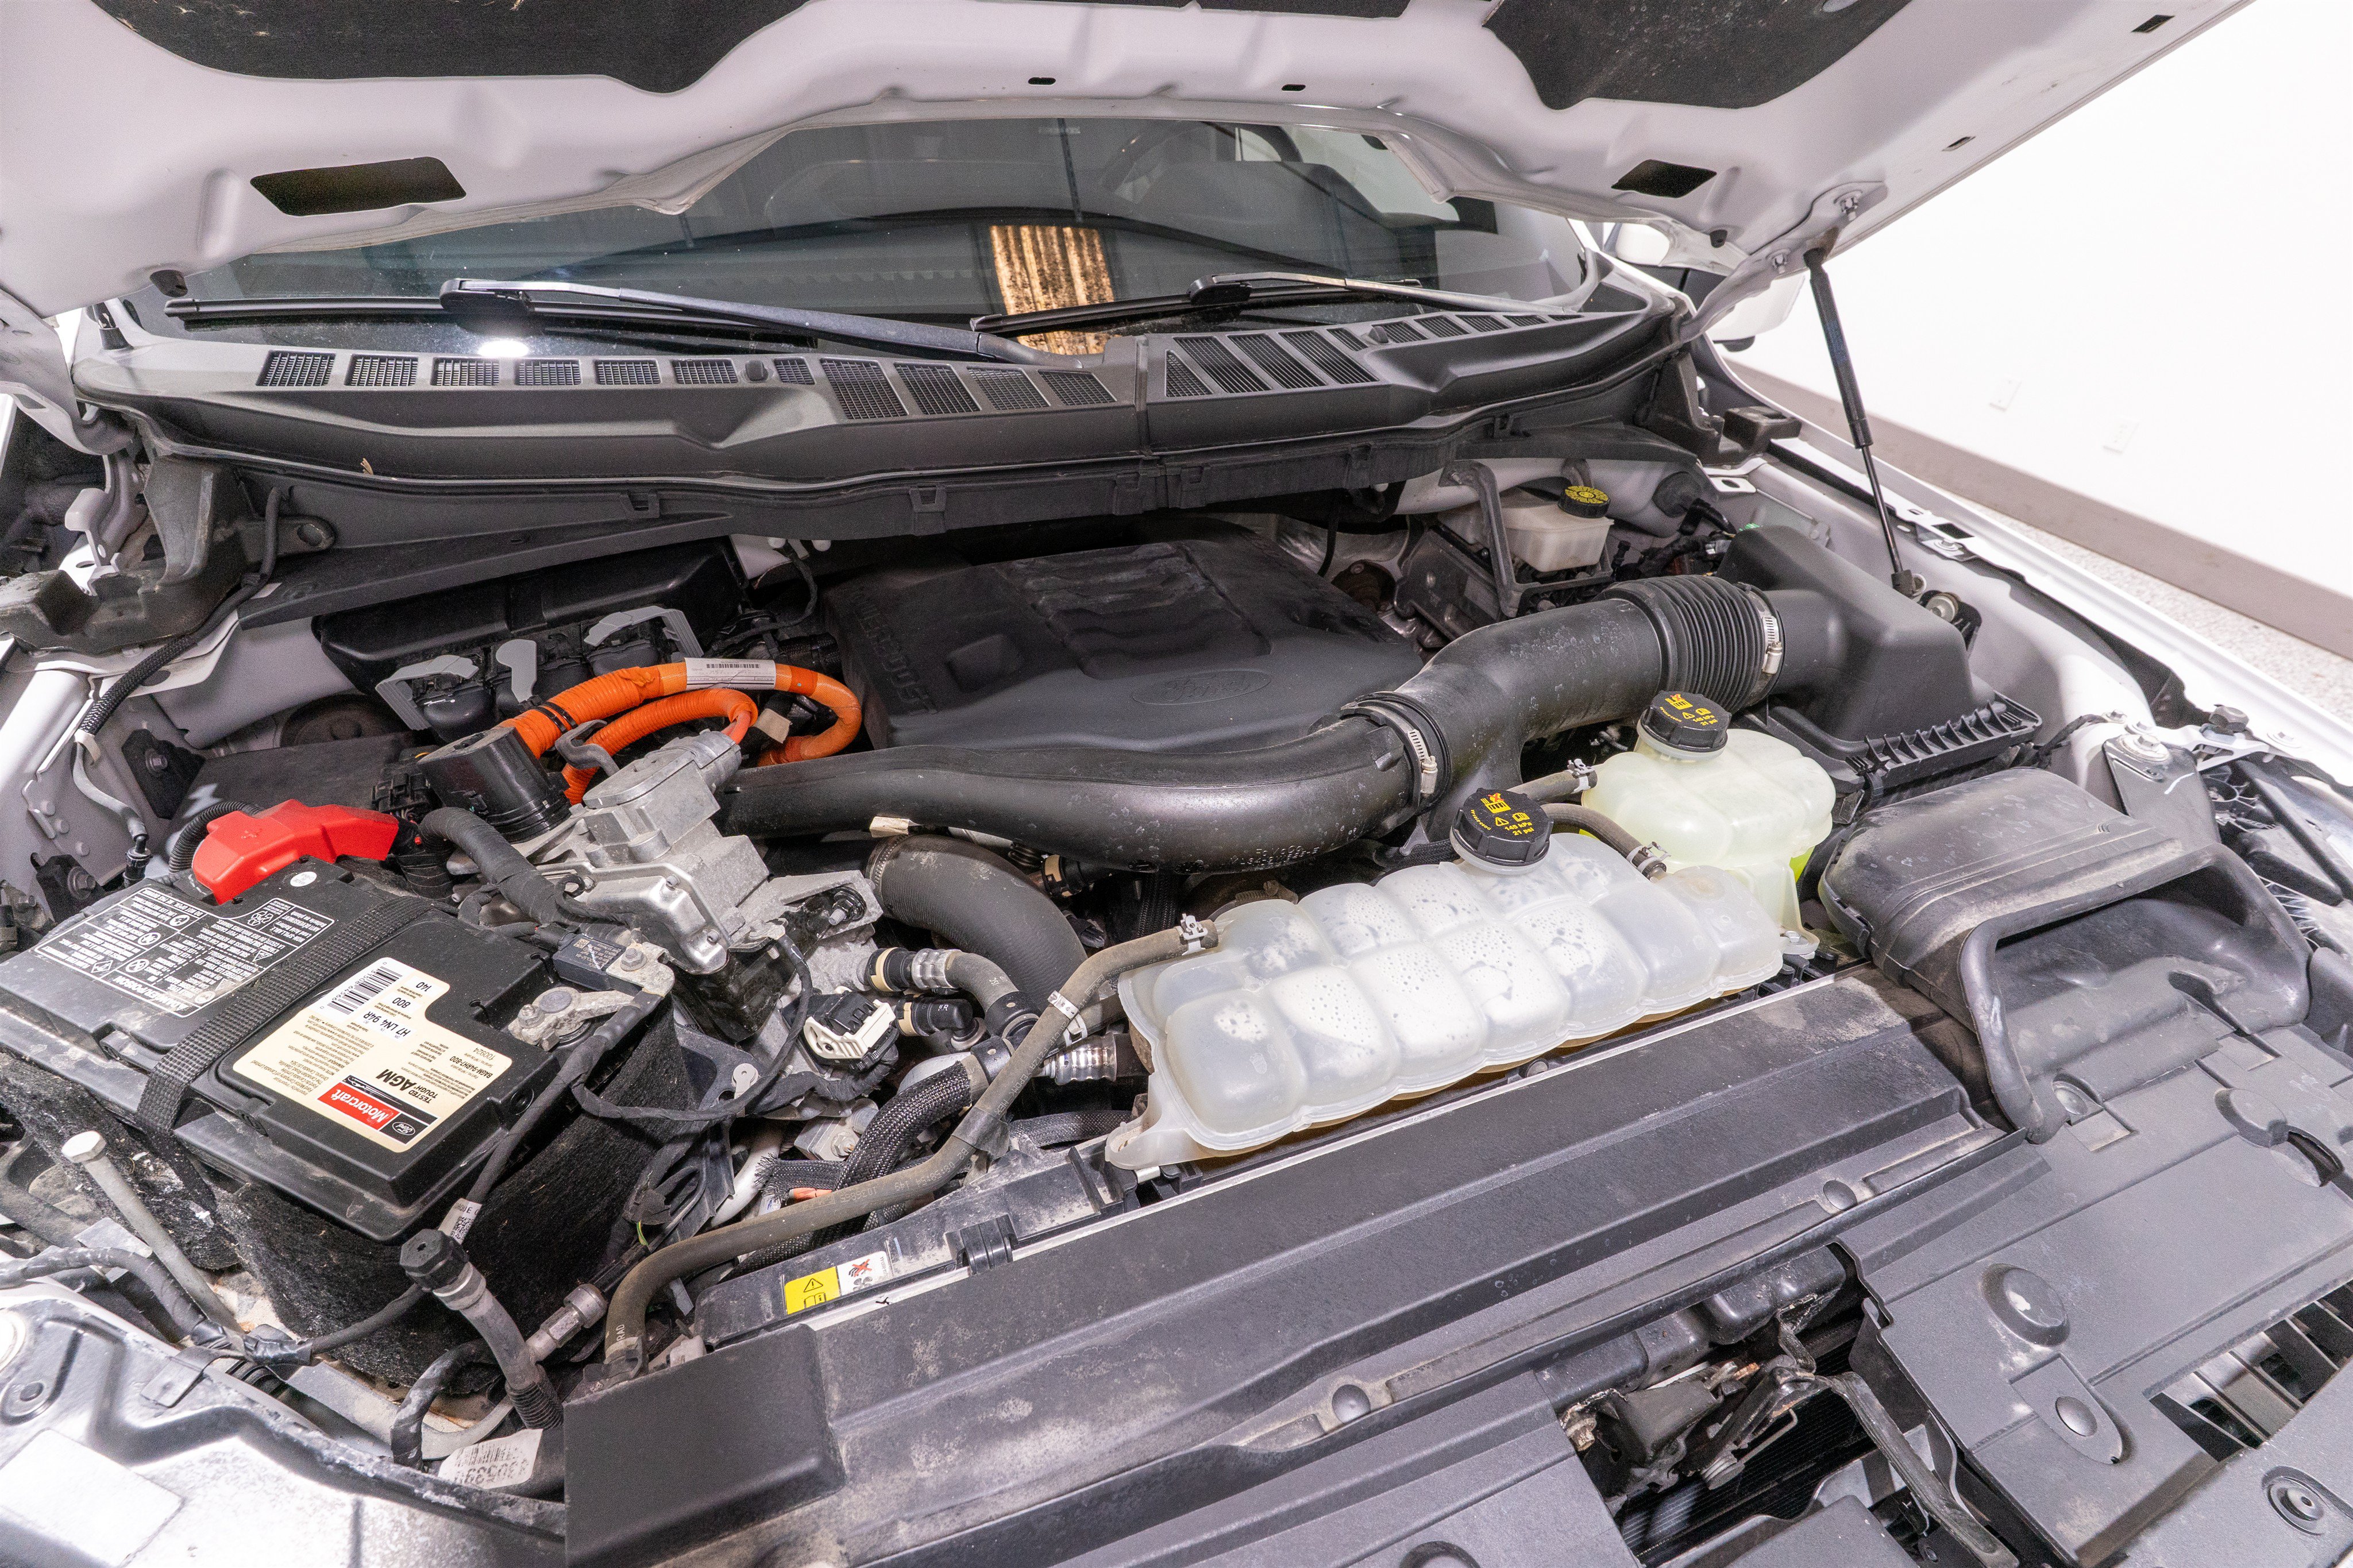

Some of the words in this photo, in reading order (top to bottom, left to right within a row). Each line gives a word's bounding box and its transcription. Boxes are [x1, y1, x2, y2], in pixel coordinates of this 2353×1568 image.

[1161, 675, 1249, 701] Ford
[290, 911, 307, 919] plomb
[210, 923, 229, 933] CAUSER
[216, 918, 234, 929] GRAVES.
[275, 921, 292, 930] Battery
[308, 918, 327, 928] Batterie
[200, 927, 217, 937] BURNS.
[269, 926, 306, 943] NON-SPILLABLE
[298, 930, 313, 939] Lead
[196, 933, 212, 942] CAUSE
[213, 933, 230, 943] SEVERE
[234, 933, 264, 948] SULFURIQUE
[226, 946, 250, 958] SULFURIC
[233, 941, 257, 953] BLINDNESS
[259, 944, 280, 955] L'ACIDE
[151, 962, 169, 972] FLAMES
[164, 975, 182, 986] GASES
[185, 977, 203, 986] CAUSE
[112, 975, 183, 1009] DANGER/POISON
[415, 982, 432, 992] 140
[392, 997, 411, 1009] 800
[363, 1011, 382, 1023] 94R
[380, 1019, 399, 1031] LN4
[395, 1028, 411, 1037] H7
[250, 1060, 266, 1069] Limited
[449, 1056, 493, 1079] BAGM-94RH7-800
[263, 1065, 277, 1075] Canada
[280, 1068, 295, 1076] Limitée
[302, 1065, 316, 1075] Canada
[279, 1073, 296, 1084] Company
[292, 1073, 307, 1083] Canada
[300, 1072, 318, 1082] Canadian
[376, 1069, 417, 1091] AGM
[294, 1081, 306, 1089] Motor
[408, 1090, 432, 1104] TESTED
[327, 1088, 391, 1124] Motorcraft
[994, 1099, 1010, 1116] MEX
[395, 1123, 414, 1136] Ford
